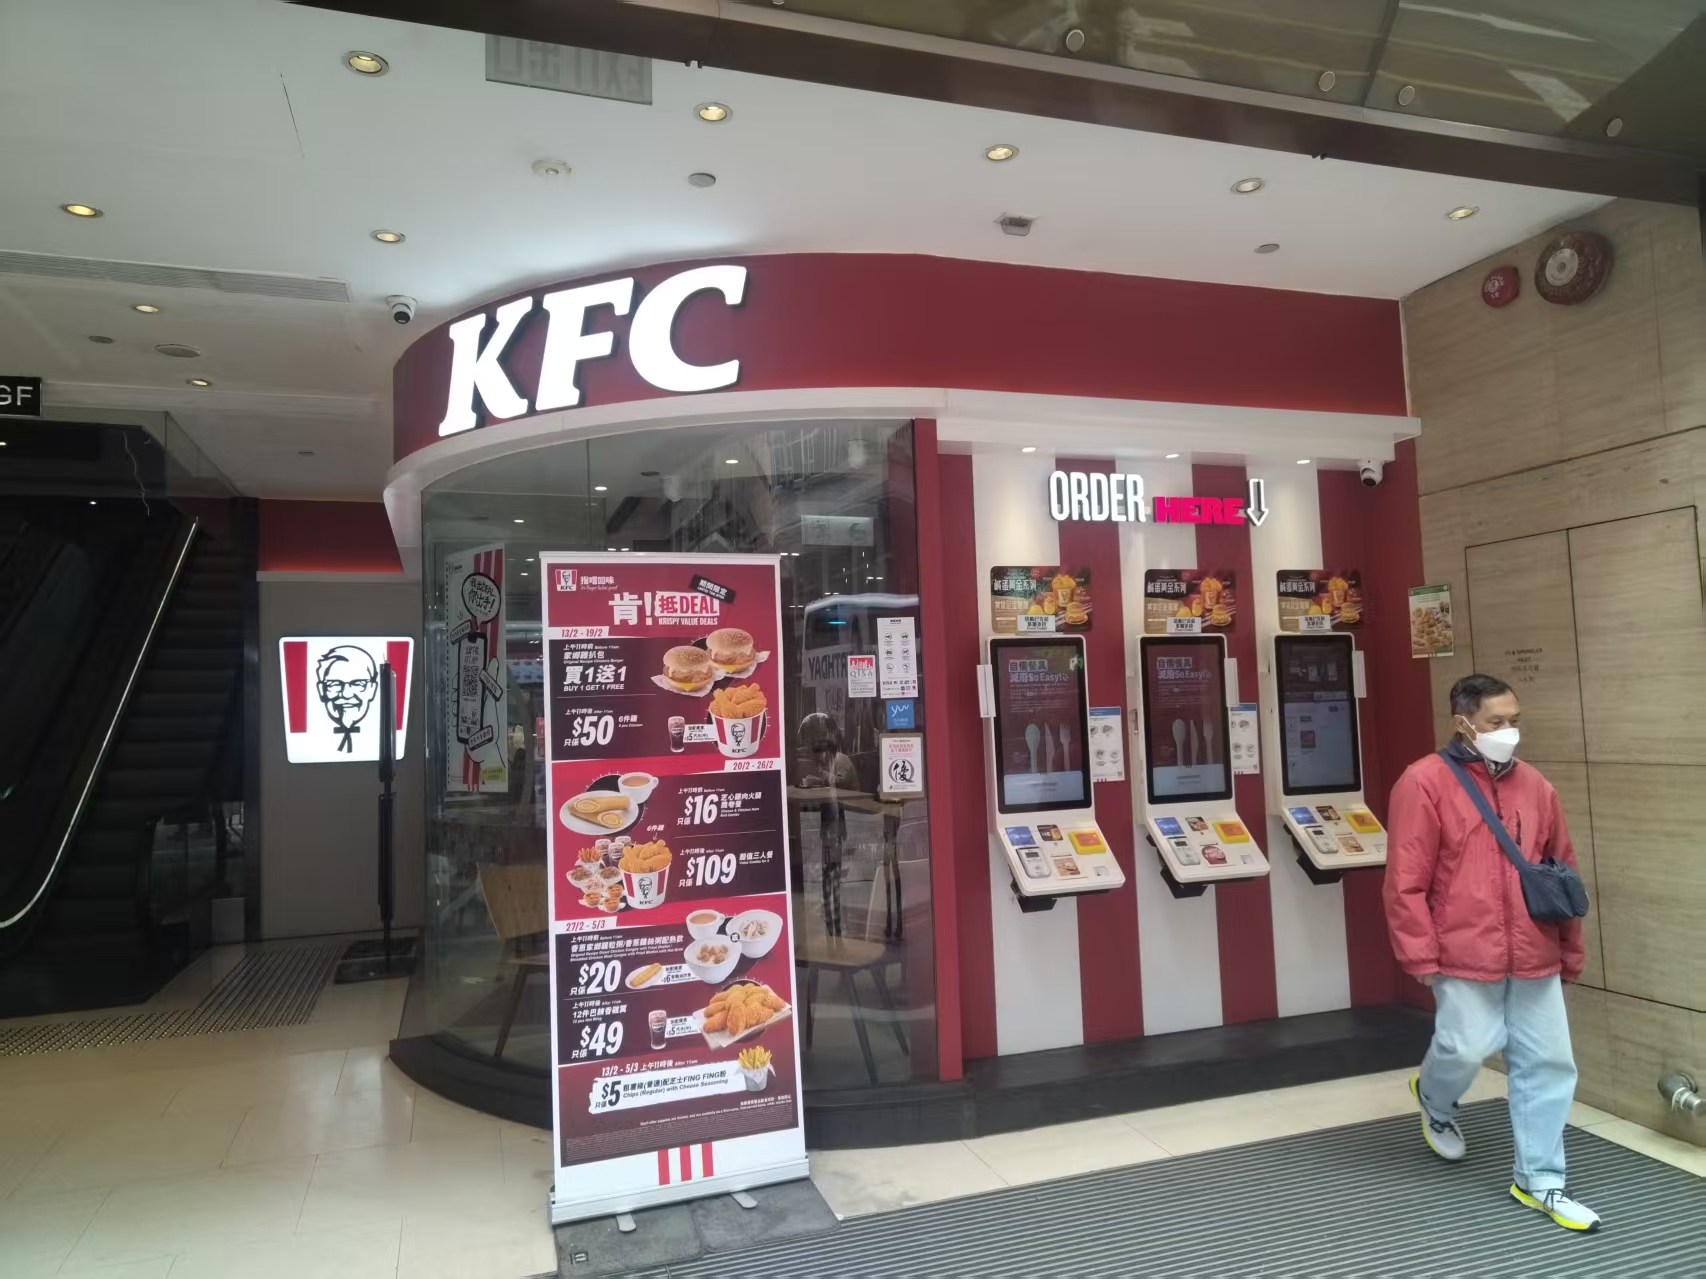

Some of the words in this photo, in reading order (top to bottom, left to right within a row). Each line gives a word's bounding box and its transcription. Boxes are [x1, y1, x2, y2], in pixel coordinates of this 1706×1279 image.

[438, 264, 748, 437] KFC
[1048, 470, 1147, 523] ORDER
[1152, 496, 1245, 526] HERE
[608, 592, 653, 626] 肯!
[658, 617, 680, 626] KRISPY
[680, 617, 699, 626] VALUE
[699, 617, 718, 626] DEALS
[561, 629, 578, 638] 13/2
[586, 628, 603, 638] 19/2
[563, 664, 627, 685] 買1送1
[572, 714, 615, 746] $50
[733, 761, 750, 771] 20/2
[757, 760, 774, 769] 26/2
[684, 793, 719, 825] $16
[686, 853, 737, 886] $109
[565, 921, 584, 932] 27/2
[591, 919, 606, 930] 5/3
[578, 959, 622, 994] $20
[580, 1020, 624, 1056] $49
[601, 1065, 618, 1077] 13/2
[625, 1062, 639, 1073] 5/3
[601, 1080, 621, 1107] $5
[623, 1091, 639, 1099] Chips
[700, 1078, 729, 1087] Seasoning
